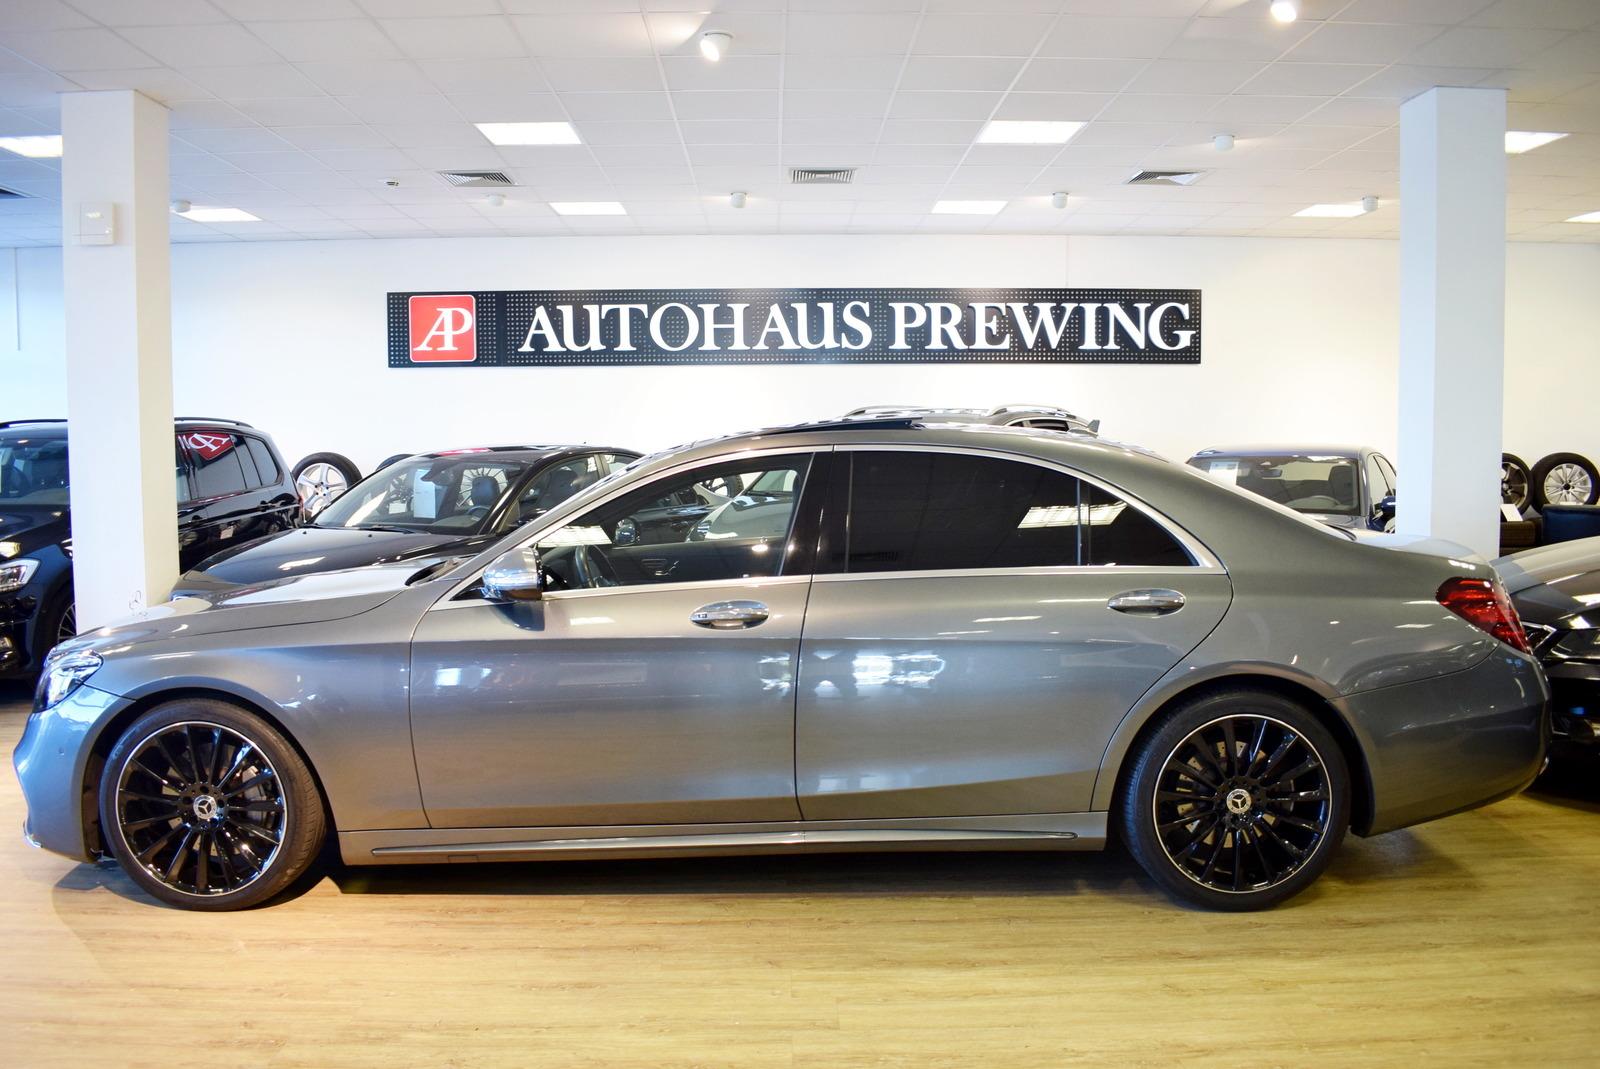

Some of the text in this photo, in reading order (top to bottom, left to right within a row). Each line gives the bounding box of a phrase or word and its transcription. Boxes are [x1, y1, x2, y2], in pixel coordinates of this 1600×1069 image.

[413, 307, 473, 351] AP
[518, 301, 1196, 352] AUTOHAUS PREWING
